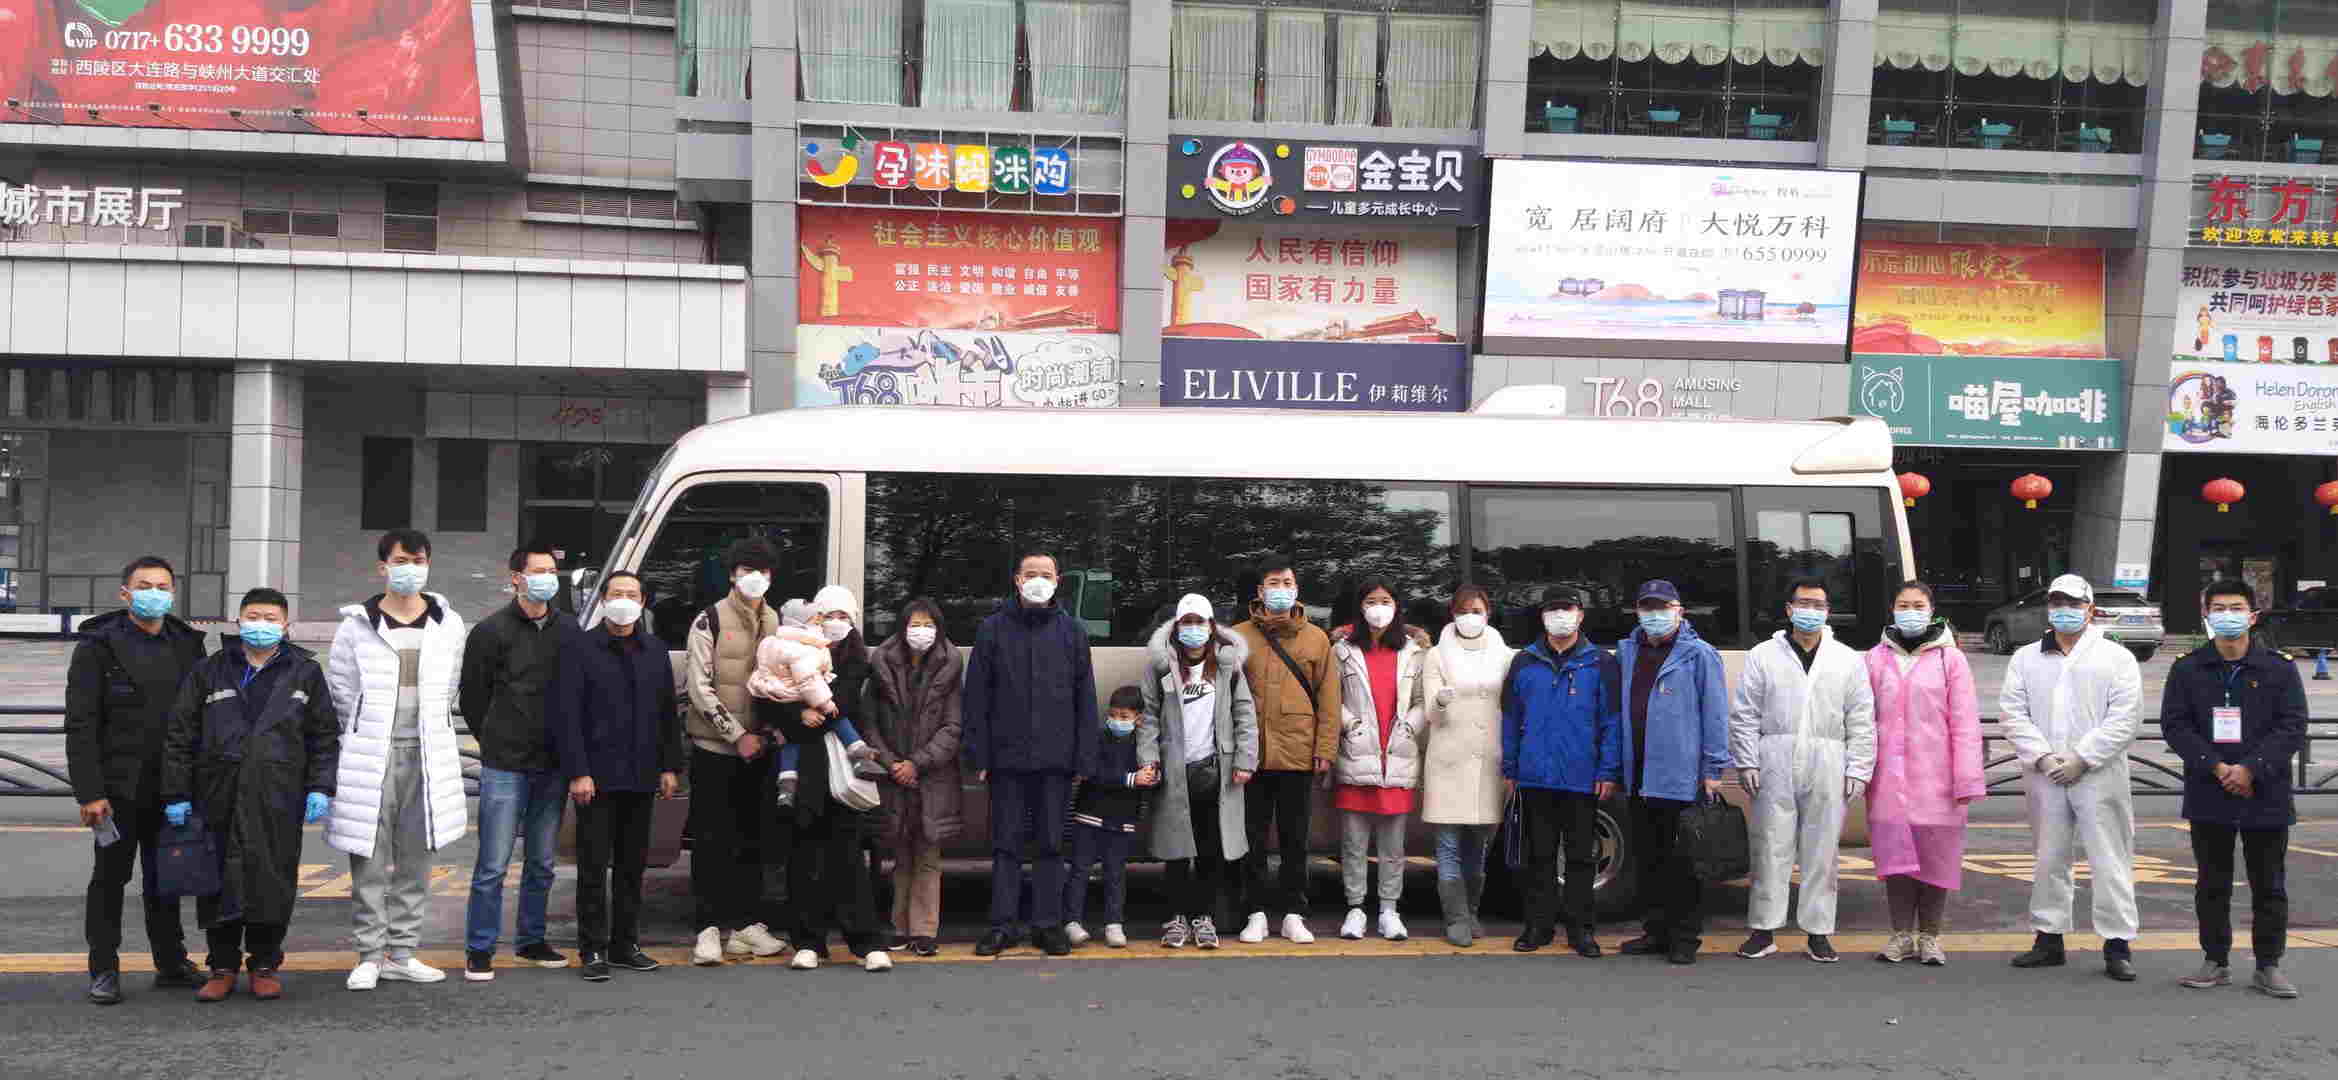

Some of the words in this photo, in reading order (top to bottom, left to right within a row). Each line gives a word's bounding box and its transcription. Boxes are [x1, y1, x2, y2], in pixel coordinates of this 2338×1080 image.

[874, 144, 1069, 191] 孕味妈咪购
[1359, 149, 1464, 192] 金宝贝
[0, 183, 183, 230] 城市展厅
[1330, 200, 1439, 216] 儿童多元成长中心
[2207, 175, 2338, 225] 东方
[873, 221, 1101, 252] 社会主义核心价值观
[1701, 210, 1831, 240] 大悦万科
[1246, 236, 1400, 268] 人民有信仰
[1246, 273, 1400, 304] 国家有力量
[2183, 265, 2338, 292] 积极参与垃圾分类
[1183, 369, 1360, 402] ELIVILLE
[1367, 383, 1449, 405] 伊莉维尔
[1583, 376, 1665, 416] T68
[1673, 377, 1744, 393] AMUSING
[2256, 382, 2295, 396] Helen
[1671, 395, 1713, 410] MALL
[1948, 380, 2107, 427] 喵屋咖啡
